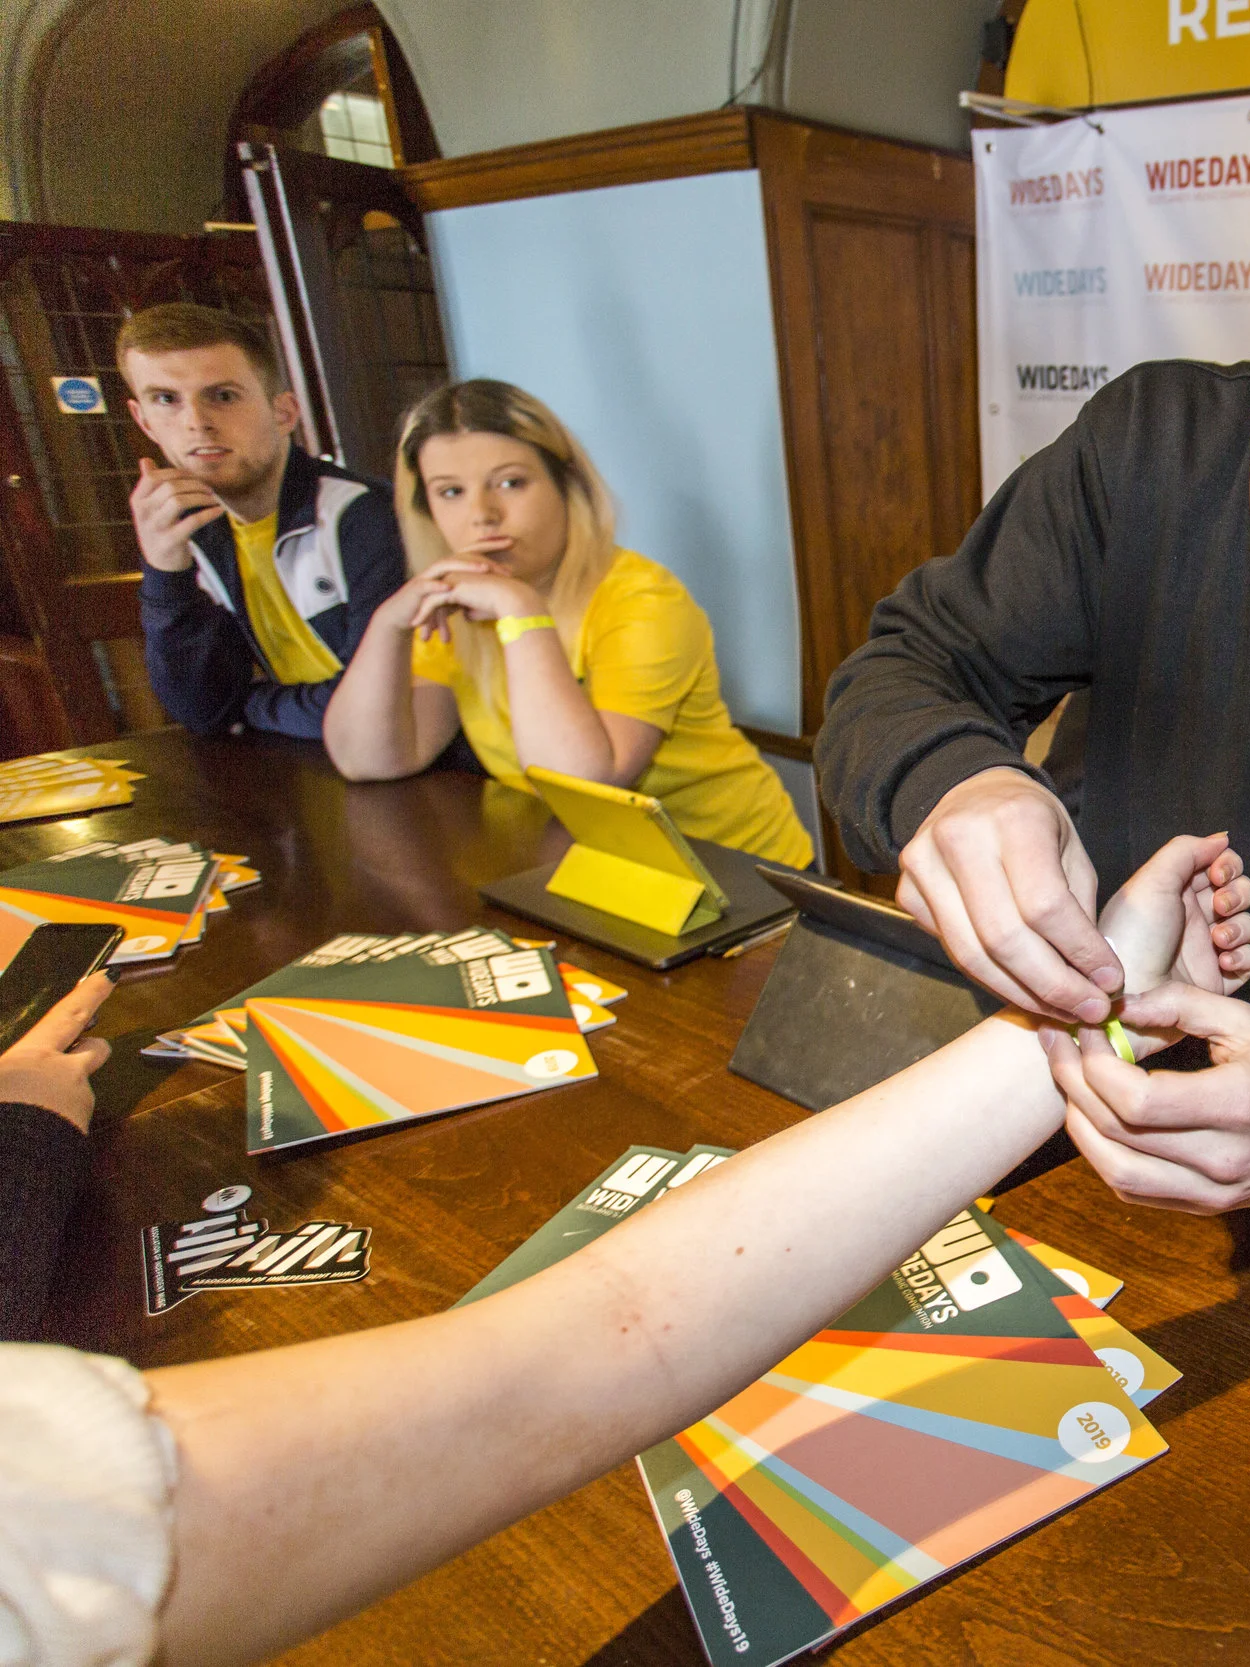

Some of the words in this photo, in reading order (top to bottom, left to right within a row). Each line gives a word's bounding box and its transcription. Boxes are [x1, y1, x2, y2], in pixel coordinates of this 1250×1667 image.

[1009, 167, 1104, 205] WIDEDAYS
[1014, 266, 1107, 296] WIDEDAYS
[1017, 364, 1109, 391] WIDEDAYS
[902, 1288, 933, 1330] CONVENTION
[1076, 1412, 1112, 1450] 2019
[674, 1488, 712, 1560] @WideDays
[705, 1560, 750, 1653] #WideDays19
